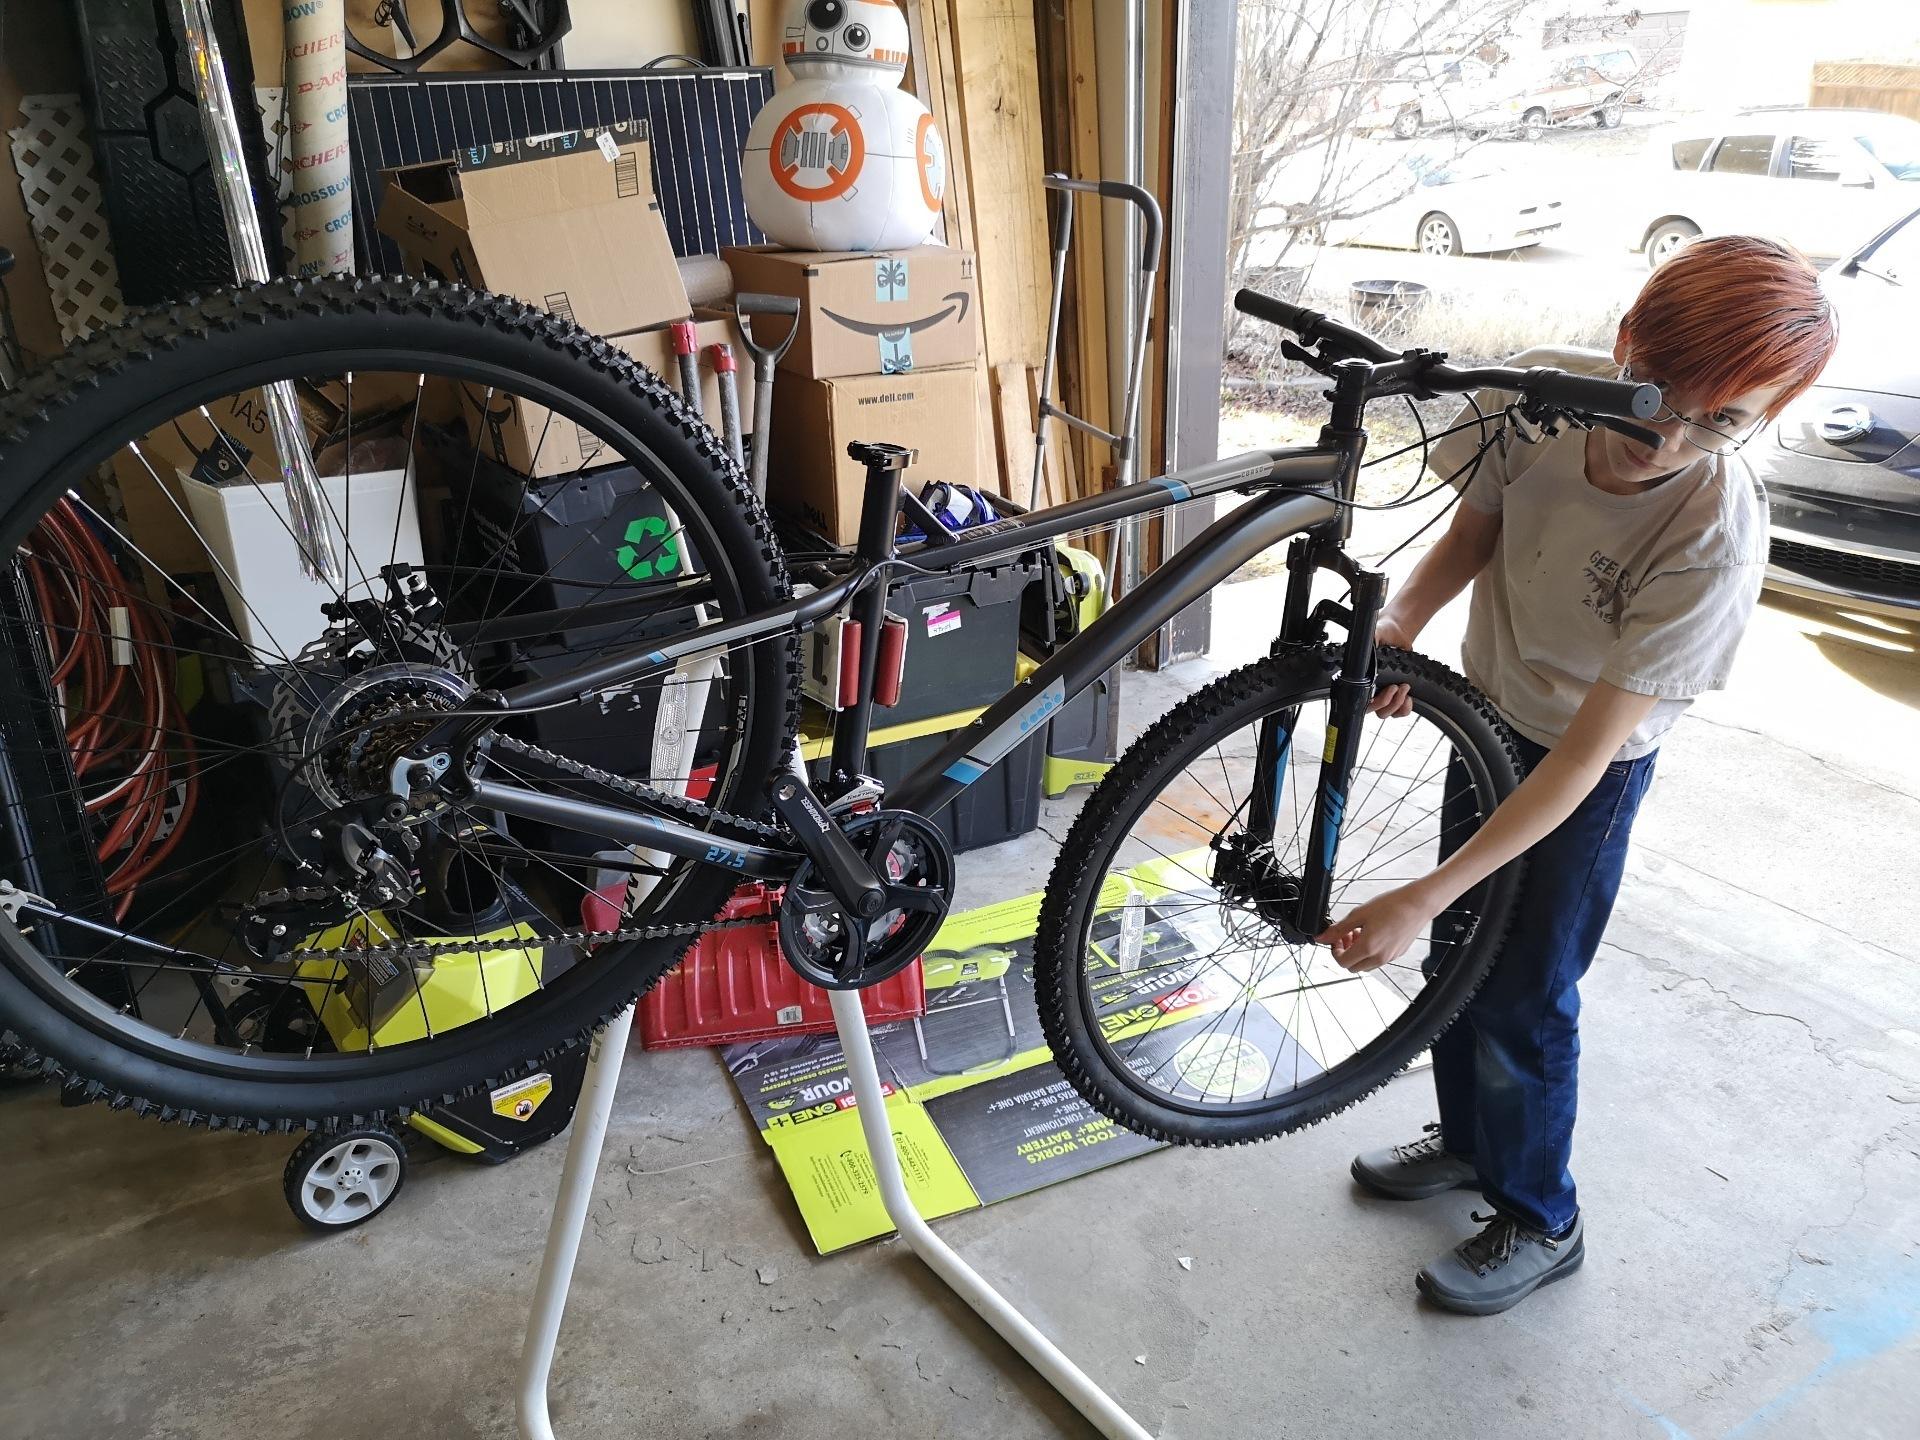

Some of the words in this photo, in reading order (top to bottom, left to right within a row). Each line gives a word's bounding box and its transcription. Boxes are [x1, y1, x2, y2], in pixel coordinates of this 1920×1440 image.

[858, 391, 914, 405] www.dell.com
[1241, 466, 1264, 478] CORSO
[705, 846, 746, 868] 27.5
[817, 1063, 847, 1076] ORDLESS
[799, 1076, 852, 1101] VOUR
[1014, 1087, 1046, 1105] BATERÍA
[772, 1101, 837, 1128] ONE+
[1023, 1112, 1083, 1138] FONCTIONNENT
[1016, 1130, 1072, 1156] BATTERY
[1077, 1129, 1117, 1146] TOOL
[1026, 1140, 1079, 1164] WORKS
